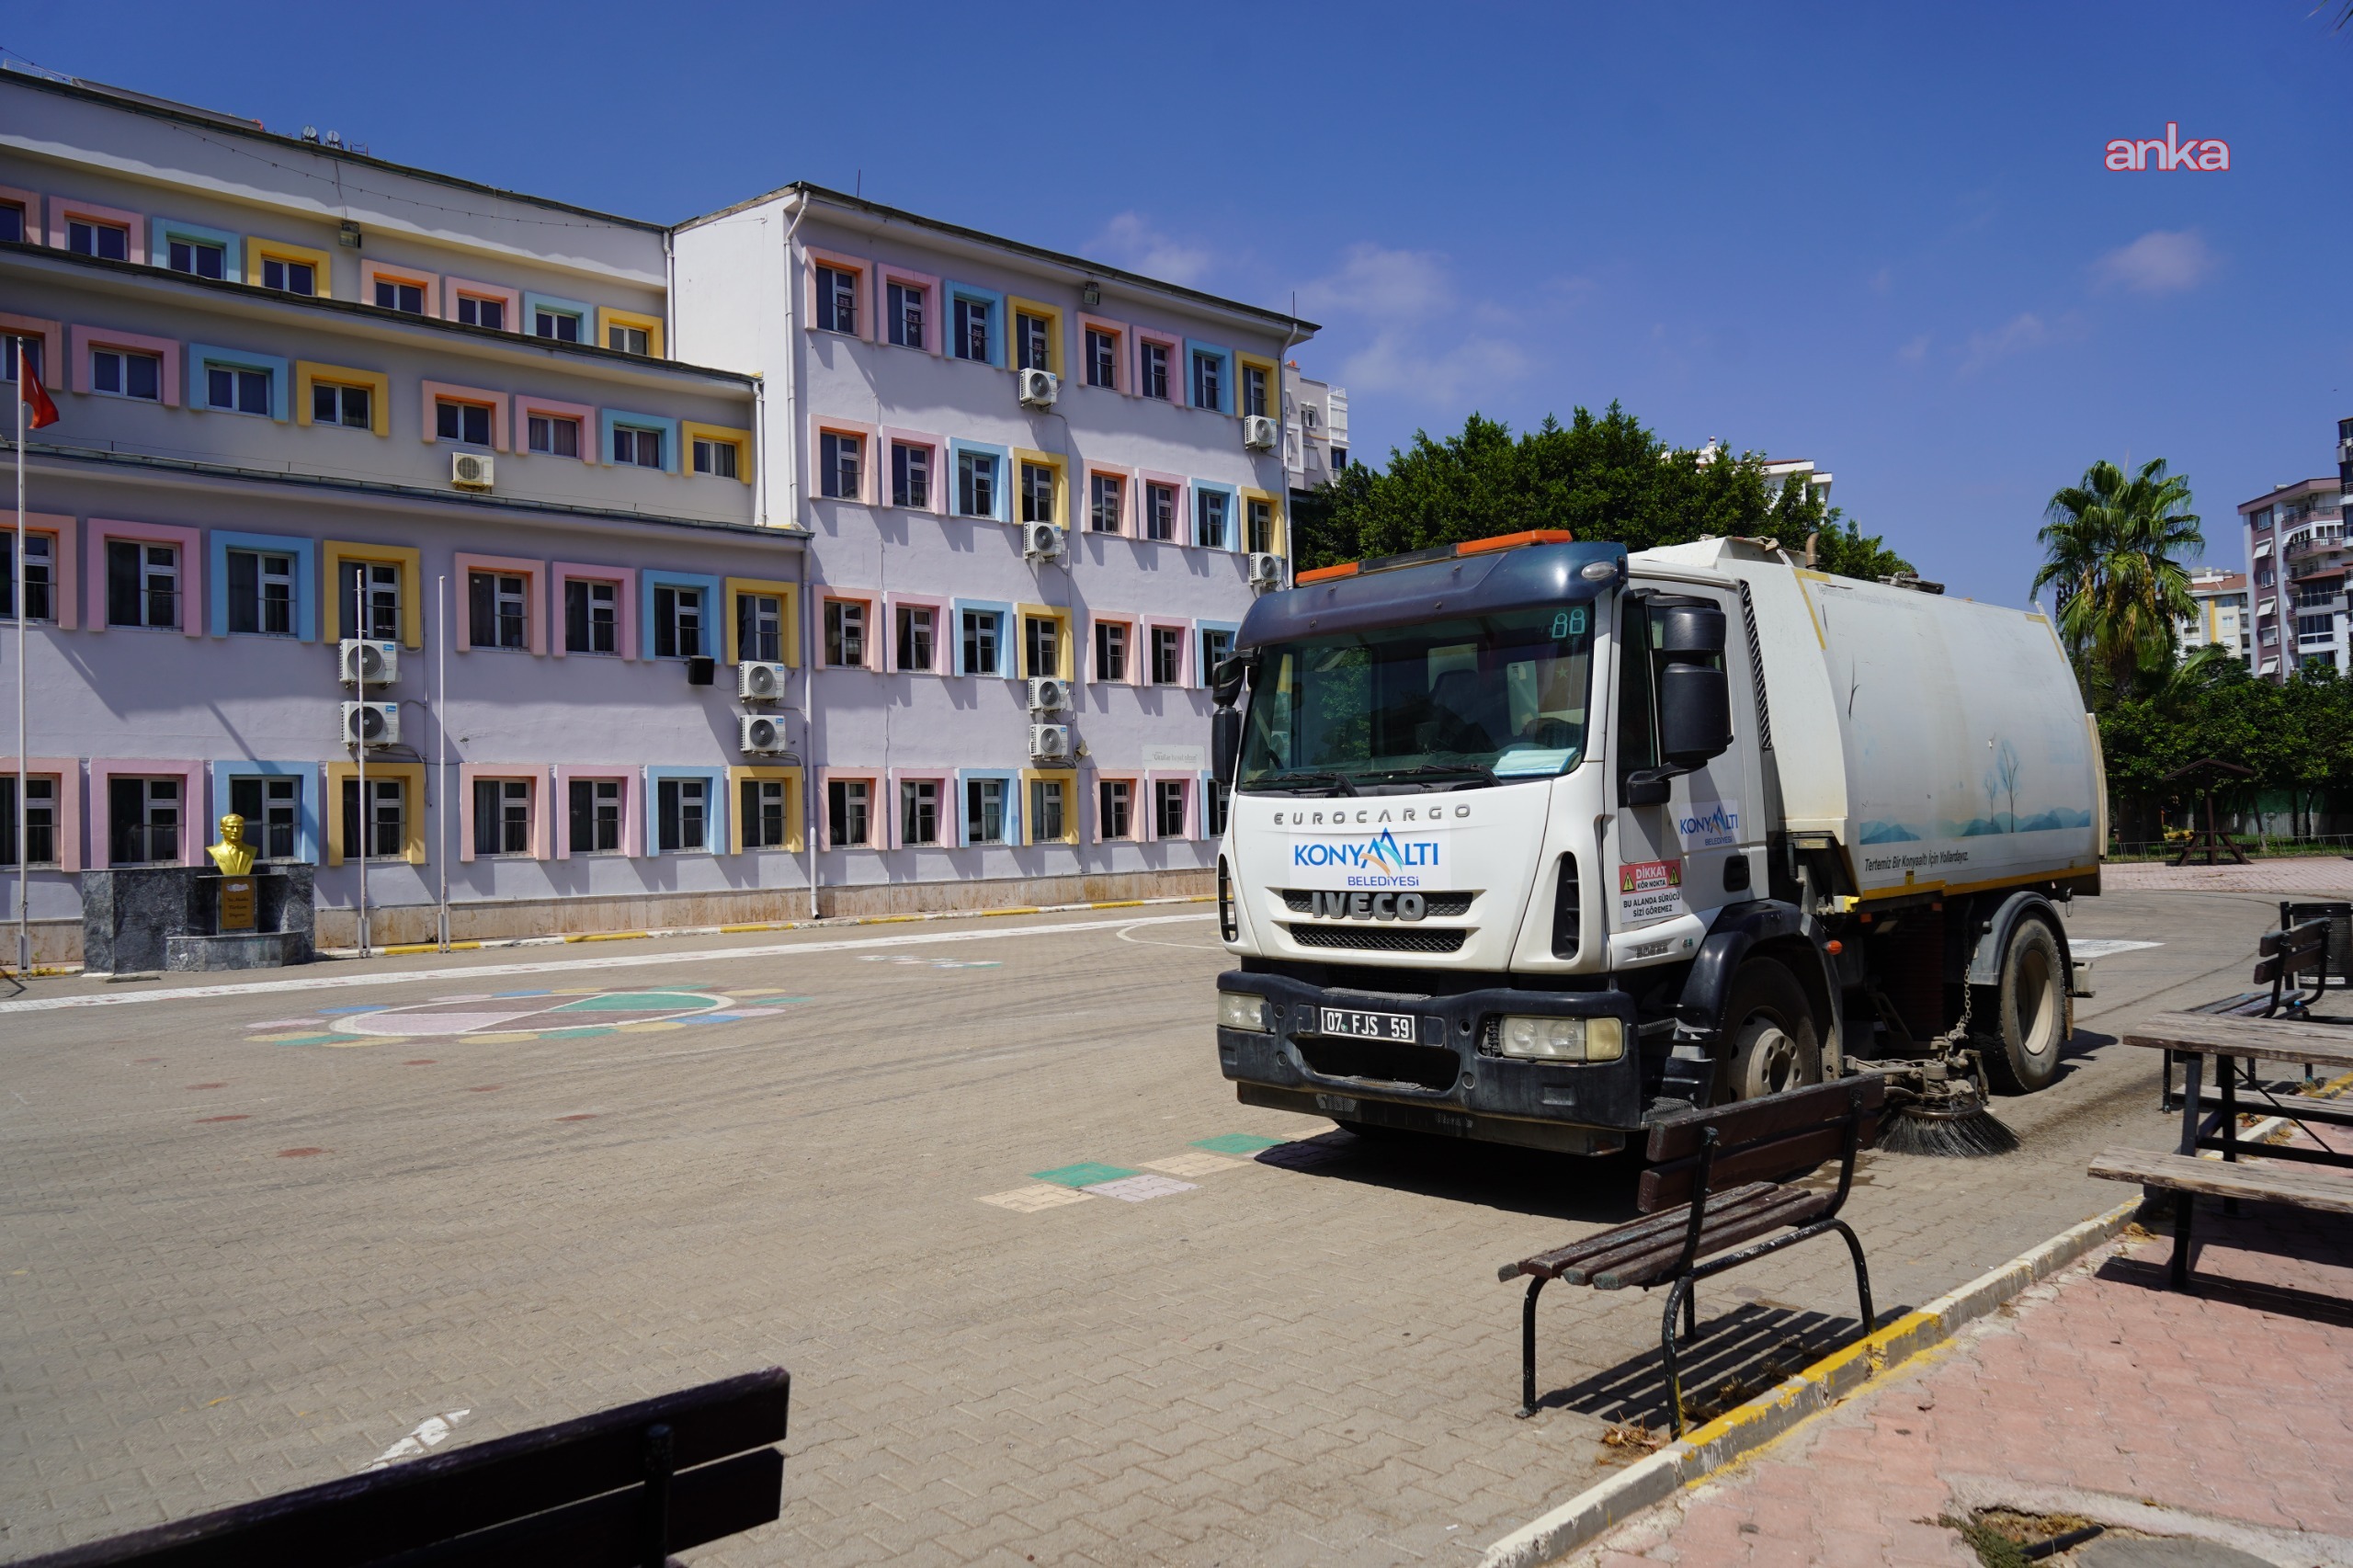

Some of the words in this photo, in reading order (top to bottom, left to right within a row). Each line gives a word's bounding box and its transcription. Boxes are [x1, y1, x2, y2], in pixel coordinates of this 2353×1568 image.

[1274, 803, 1471, 825] EUROCARGO
[1680, 804, 1739, 835] KONYAALTI
[1294, 826, 1439, 870] KONYAALTI
[1636, 866, 1667, 880] DİKKAT
[1865, 856, 1892, 872] Tertemiz
[1893, 855, 1901, 869] Bir
[1637, 881, 1649, 890] KÖR
[1649, 879, 1666, 888] NOKTA
[1312, 891, 1427, 922] IVECO
[1623, 900, 1632, 908] BU
[1633, 896, 1657, 906] ALANDA
[1658, 891, 1680, 903] SÜRÜCÜ
[1633, 906, 1644, 917] SİZİ
[1645, 904, 1673, 915] GÖREMEZ
[1326, 1011, 1343, 1032] 07
[1352, 1014, 1379, 1036] FJS
[1391, 1017, 1410, 1039] 59
